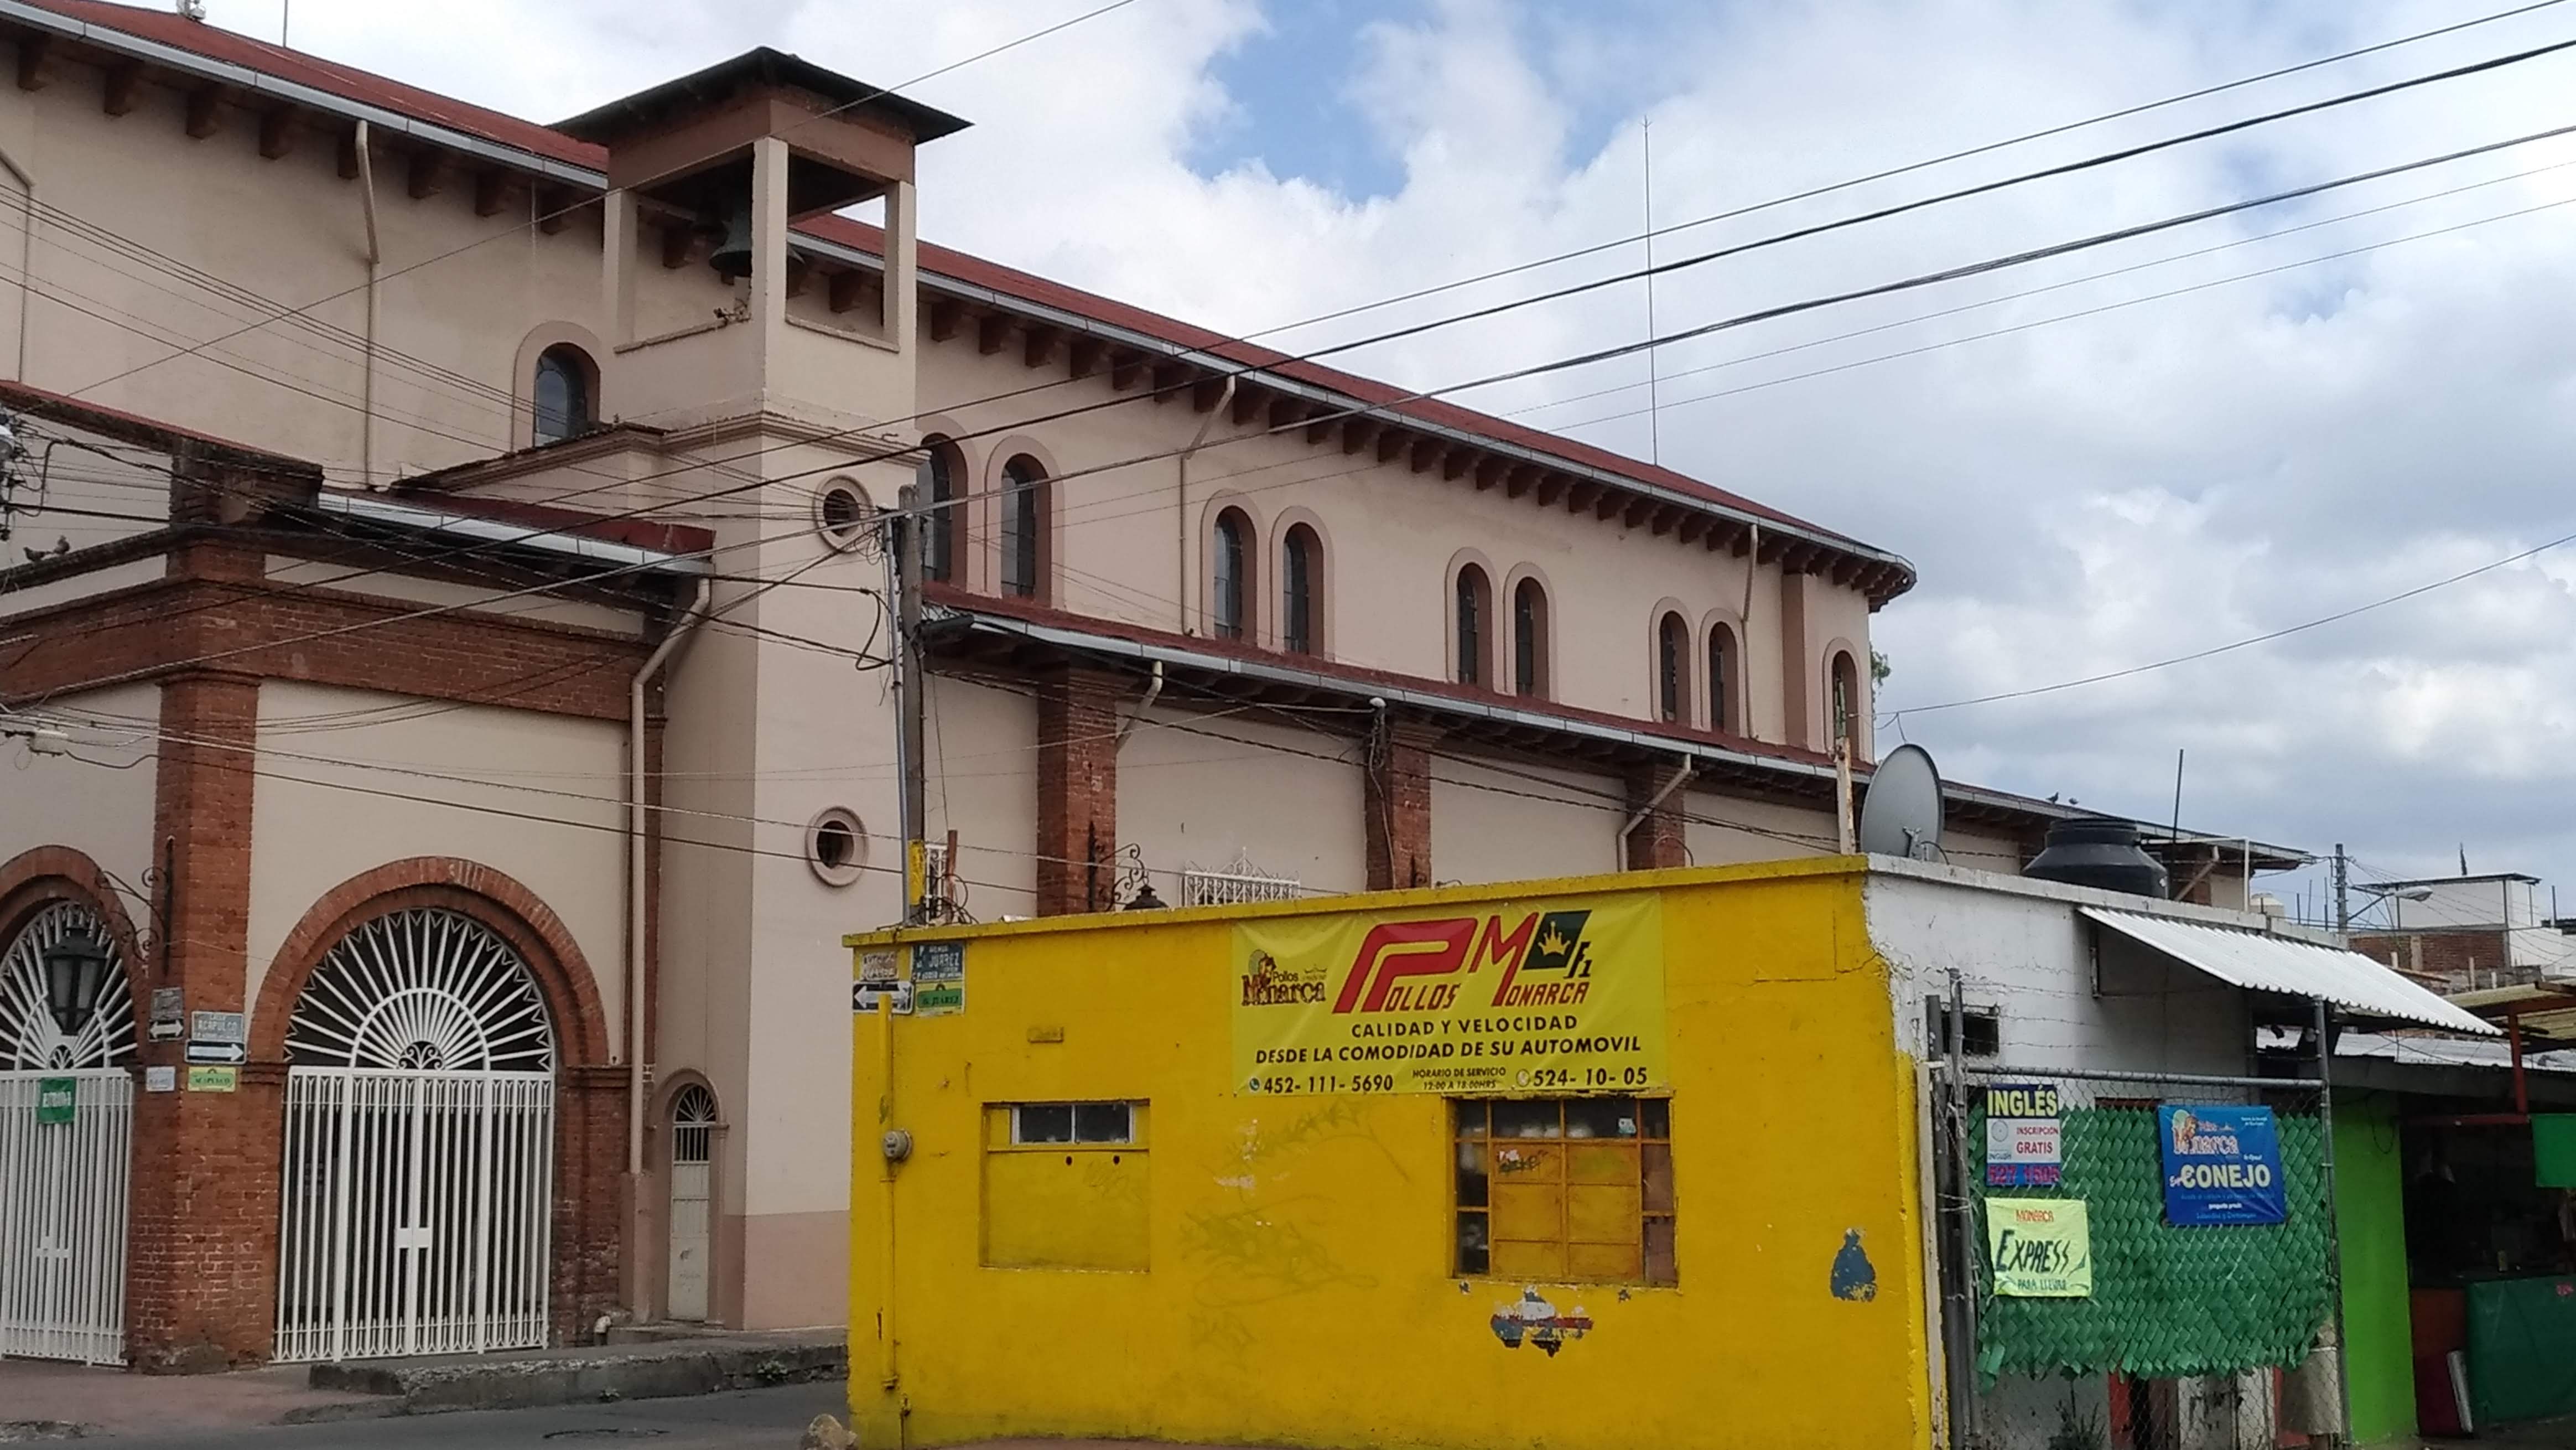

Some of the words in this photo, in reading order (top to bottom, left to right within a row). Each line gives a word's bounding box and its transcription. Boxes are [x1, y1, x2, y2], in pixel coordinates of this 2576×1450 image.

[1273, 970, 1299, 982] Pollos
[1352, 1022, 1434, 1038] CALIDAD
[1441, 1019, 1454, 1035] Y
[1458, 1016, 1577, 1033] VELOCIDAD
[1256, 1047, 1307, 1065] DESDE
[1313, 1046, 1334, 1061] LA
[1338, 1042, 1455, 1061] COMODIDAD
[1460, 1041, 1484, 1057] DE
[1489, 1040, 1515, 1056] SU
[1519, 1035, 1642, 1055] AUTOMOVIL
[1412, 1069, 1451, 1078] HORARIO
[1454, 1068, 1464, 1077] DE
[1466, 1066, 1506, 1076] SERVICIO
[1623, 1066, 1648, 1084] 05
[1351, 1074, 1394, 1092] 5690
[1987, 1085, 2057, 1116] INGLÉS
[2017, 1141, 2053, 1154] GRATIS
[2181, 1164, 2271, 1188] CONEJO
